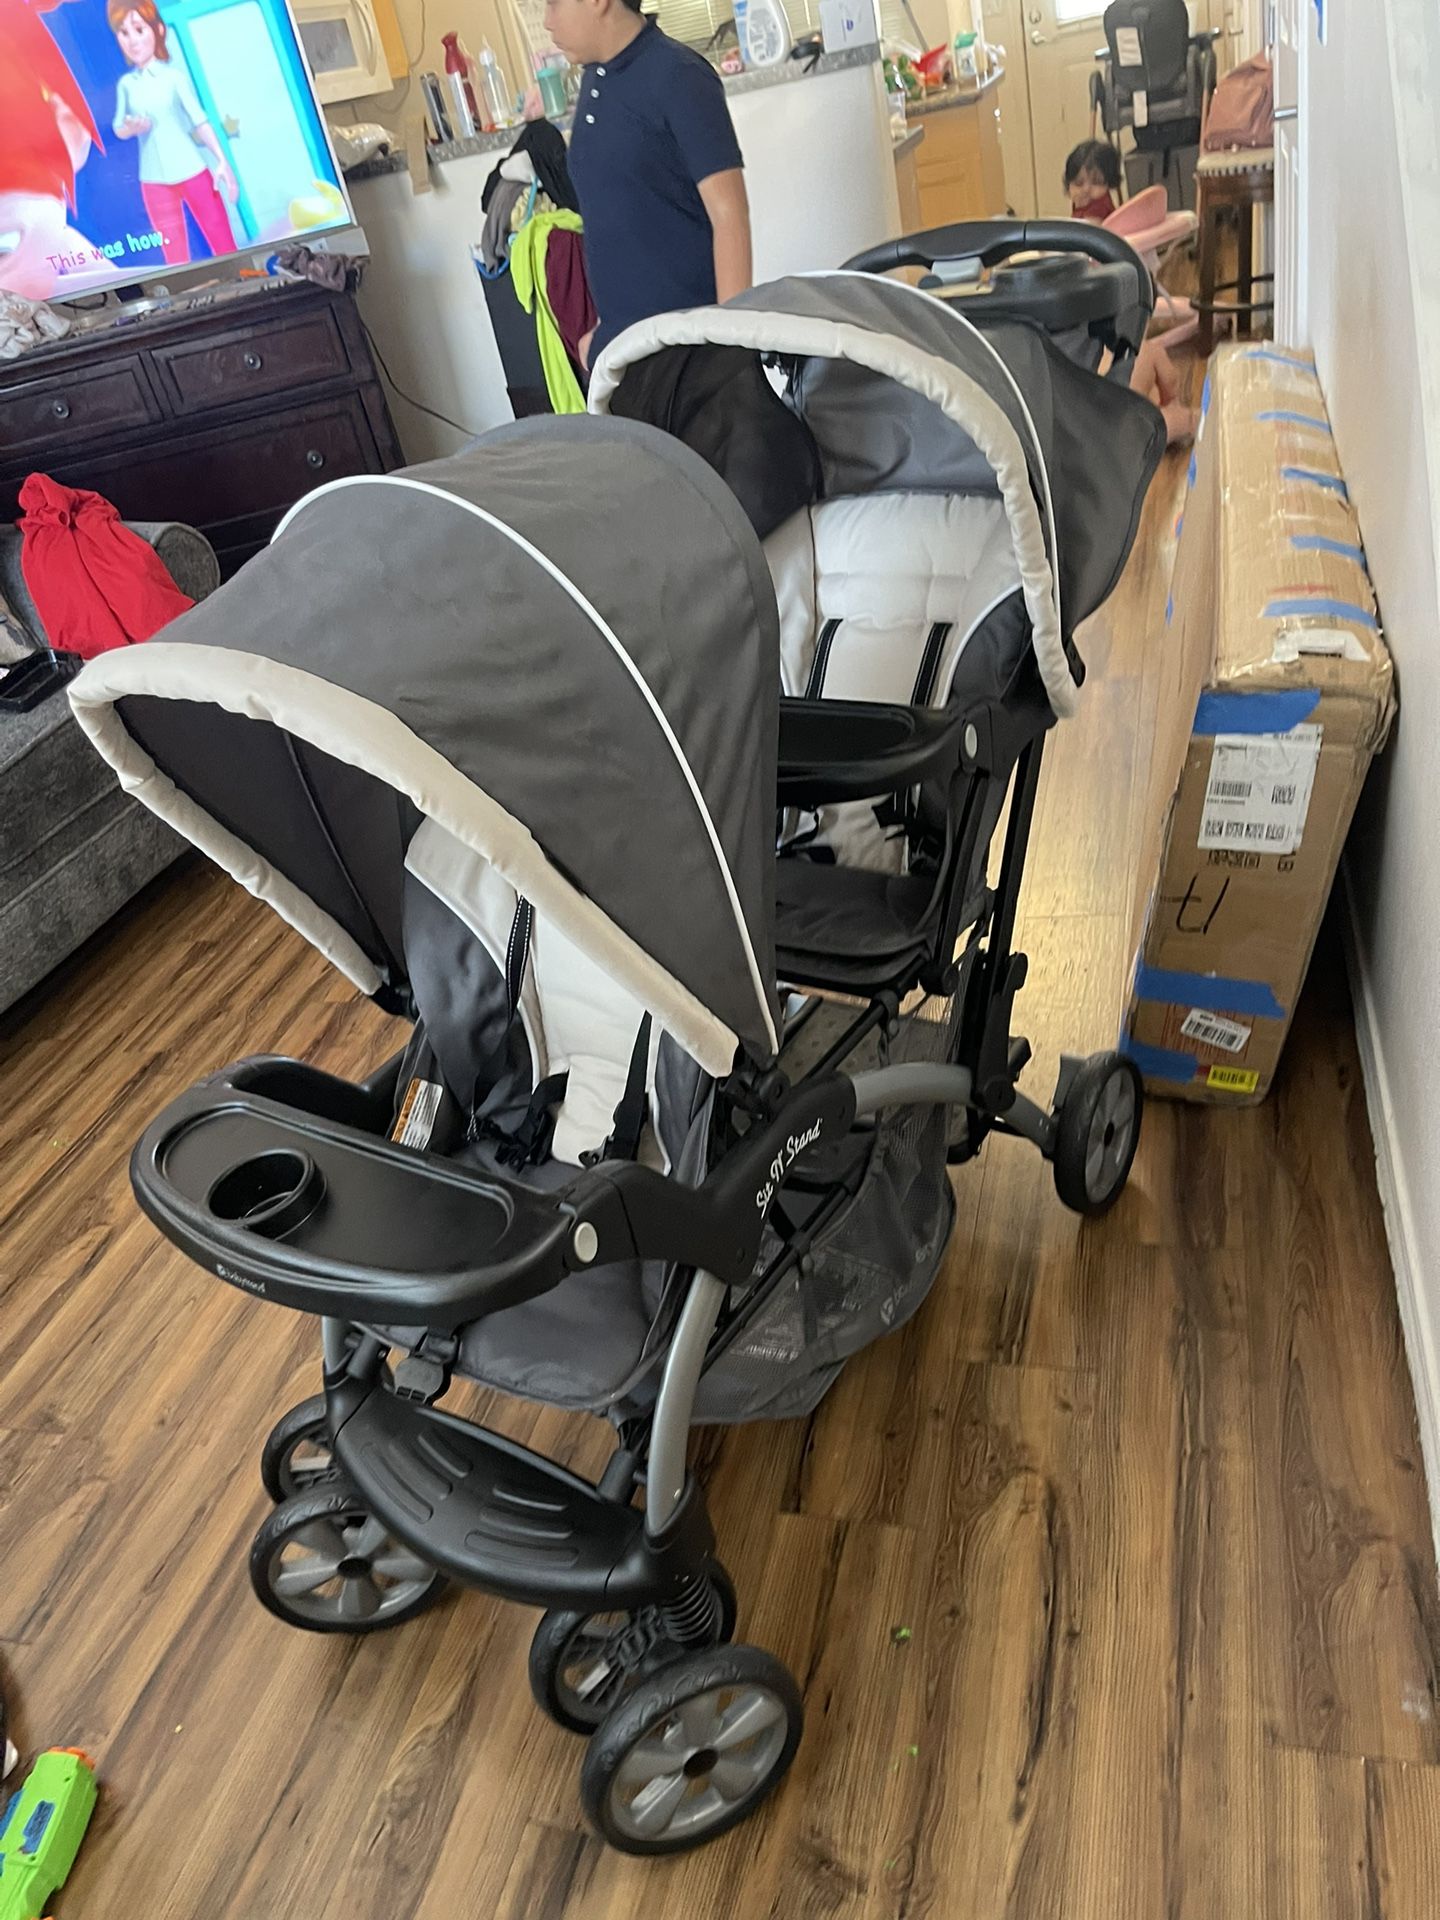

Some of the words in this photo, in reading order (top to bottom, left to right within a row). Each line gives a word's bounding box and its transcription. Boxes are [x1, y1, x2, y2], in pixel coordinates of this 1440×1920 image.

[46, 251, 86, 270] This
[91, 240, 125, 260] was
[126, 231, 170, 253] how.
[756, 1181, 774, 1220] Sit
[786, 1118, 821, 1167] Stand
